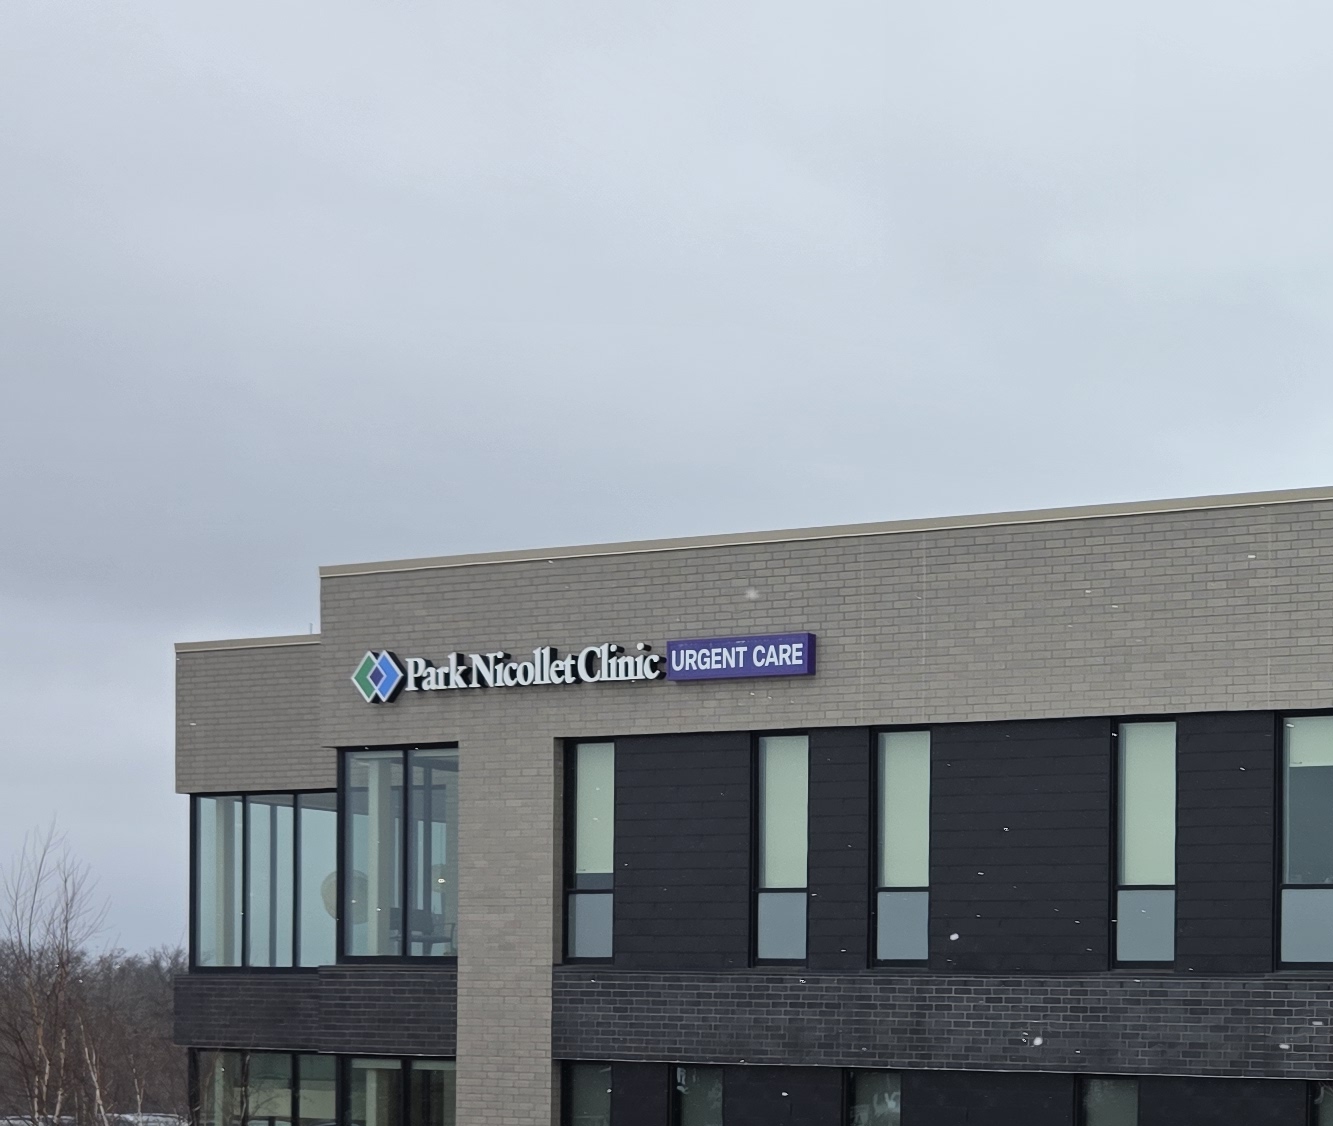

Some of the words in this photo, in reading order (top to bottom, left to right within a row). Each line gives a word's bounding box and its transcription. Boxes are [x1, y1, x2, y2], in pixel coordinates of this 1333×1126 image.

[405, 652, 468, 691] Park
[468, 646, 576, 688] Nicollet
[577, 642, 661, 683] Clinic
[671, 647, 748, 672] URGENT
[752, 643, 804, 668] CARE
